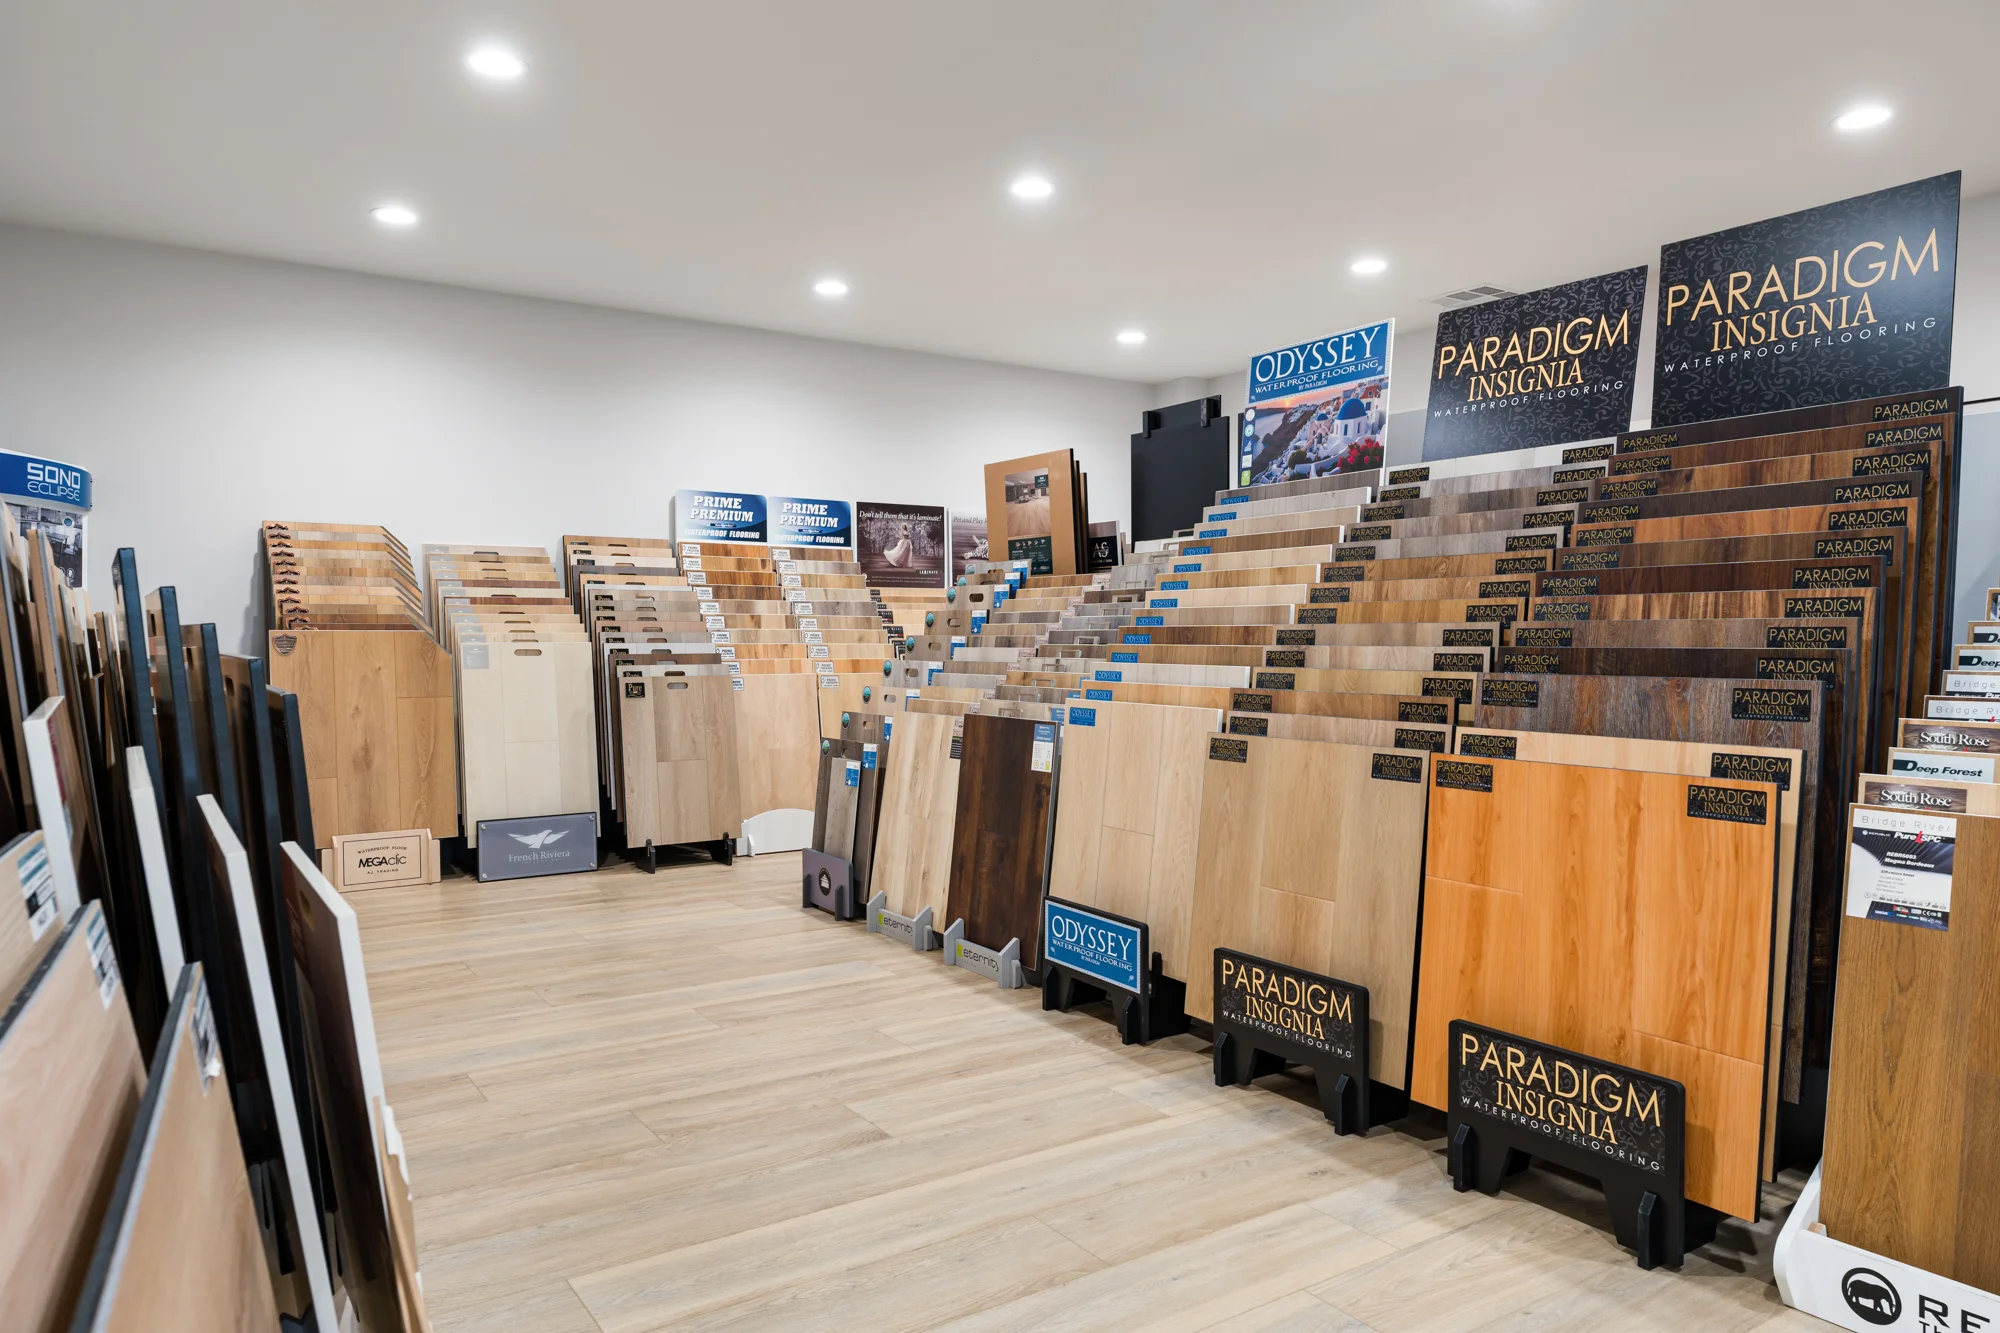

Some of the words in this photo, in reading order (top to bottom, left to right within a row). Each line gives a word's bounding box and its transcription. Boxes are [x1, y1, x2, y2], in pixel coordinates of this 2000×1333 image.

[1666, 227, 1939, 326] PARADIGM
[1711, 292, 1877, 352] INSIGNIA
[1438, 309, 1629, 380] PARADIGM
[1664, 342, 1798, 373] WATERPROOF
[1814, 317, 1936, 347] FLOORING
[1255, 326, 1381, 382] ODYSSEY
[1255, 374, 1319, 394] WATERPROOF
[1321, 360, 1378, 379] FLOORING
[1468, 358, 1584, 402] INSIGNIA
[1434, 396, 1529, 417] WATERPROOF
[1539, 381, 1624, 401] FLOORING
[1874, 398, 1948, 418] PARADIGM
[1623, 434, 1678, 448] PARADIGM
[1867, 426, 1942, 444] PARADIGM
[1563, 447, 1613, 460] PARADIGM
[1615, 458, 1670, 470] PARADIGM
[1854, 452, 1928, 470] PARADIGM
[27, 462, 81, 489] SONO
[1390, 468, 1429, 479] PARADIGM
[1555, 469, 1605, 482] PARADIGM
[27, 481, 80, 501] ECLIPSE
[1381, 488, 1420, 498] PARADIGM
[1601, 480, 1657, 494] PARADIGM
[1835, 484, 1910, 500] PARADIGM
[1538, 490, 1588, 502] PARADIGM
[693, 496, 743, 509] PRIME
[782, 502, 828, 515] PRIME
[690, 509, 753, 522] PREMIUM
[898, 512, 908, 520] that
[909, 512, 917, 520] it's
[917, 513, 942, 521] laminate!
[1210, 513, 1234, 522] ODYSSEY
[1364, 507, 1403, 516] PARADIGM
[1585, 505, 1639, 518] PARADIGM
[779, 515, 838, 528] PREMIUM
[1524, 512, 1574, 525] PARADIGM
[1830, 510, 1905, 526] PARADIGM
[685, 529, 727, 537] WATERPROOF
[729, 530, 760, 539] FLOORING
[1201, 530, 1226, 538] ODYSSEY
[1351, 527, 1390, 536] PARADIGM
[1577, 529, 1632, 541] PARADIGM
[816, 536, 844, 544] FLOORING
[1506, 535, 1556, 548] PARADIGM
[1186, 548, 1209, 556] ODYSSEY
[1336, 548, 1375, 557] PARADIGM
[1817, 539, 1892, 554] PARADIGM
[1496, 559, 1546, 570] PARADIGM
[1562, 553, 1618, 565] PARADIGM
[1176, 564, 1200, 573] ODYSSEY
[1324, 567, 1363, 576] PARADIGM
[1795, 567, 1870, 582] PARADIGM
[1163, 581, 1188, 590] ODYSSEY
[1480, 582, 1530, 593] PARADIGM
[1542, 577, 1597, 588] PARADIGM
[1808, 581, 1853, 589] INSIGNIA
[1311, 588, 1349, 597] PARADIGM
[1152, 599, 1176, 607] ODYSSEY
[1535, 604, 1589, 613] PARADIGM
[1786, 599, 1862, 612] PARADIGM
[1299, 609, 1336, 617] PARADIGM
[1467, 606, 1517, 616] PARADIGM
[1138, 617, 1163, 625] ODYSSEY
[1125, 635, 1150, 643] ODYSSEY
[1443, 631, 1493, 640] PARADIGM
[1517, 628, 1571, 639] PARADIGM
[1769, 628, 1845, 641] PARADIGM
[1783, 641, 1828, 649] INSIGNIA
[1113, 653, 1138, 662] ODYSSEY
[1266, 652, 1304, 660] PARADIGM
[1435, 655, 1483, 665] PARADIGM
[1504, 655, 1559, 665] PARADIGM
[1759, 659, 1835, 673] PARADIGM
[1097, 671, 1121, 680] ODYSSEY
[1257, 674, 1294, 682] PARADIGM
[628, 683, 642, 692] Pure
[1424, 680, 1472, 690] PARADIGM
[1483, 681, 1537, 692] PARADIGM
[1954, 680, 1996, 689] Bridge
[1088, 691, 1110, 699] ODYSSEY
[1234, 695, 1271, 704] PARADIGM
[1734, 690, 1809, 706] PARADIGM
[1072, 709, 1094, 718] ODYSSEY
[1400, 704, 1448, 715] PARADIGM
[1748, 704, 1794, 716] INSIGNIA
[1936, 706, 1978, 715] Bridge
[1230, 717, 1267, 726] PARADIGM
[1396, 730, 1444, 743] PARADIGM
[1461, 736, 1515, 748] PARADIGM
[1920, 730, 1955, 745] South
[1958, 733, 1990, 747] Rose
[1211, 739, 1247, 749] PARADIGM
[1373, 754, 1421, 768] PARADIGM
[1713, 754, 1789, 773] PARADIGM
[1437, 762, 1492, 776] PARADIGM
[1892, 759, 1939, 775] Deep
[1941, 766, 1983, 777] Forest
[1728, 769, 1773, 783] INSIGNIA
[1689, 787, 1766, 807] PARADIGM
[1881, 789, 1917, 804] South
[1920, 792, 1952, 807] Rose
[1704, 802, 1750, 816] INSIGNIA
[1862, 815, 1905, 828] Bridge
[1914, 820, 1951, 832] River
[357, 846, 389, 854] WATERPROOF
[508, 851, 538, 862] French
[540, 850, 570, 860] Riviera
[1906, 860, 1935, 868] Bordeaux
[1052, 915, 1132, 961] ODYSSEY
[963, 948, 999, 972] eternity
[1052, 939, 1094, 957] WATERPROOF
[1095, 954, 1132, 971] FLOORING
[1222, 959, 1352, 1024] PARADIGM
[1245, 995, 1325, 1040] INSIGNIA
[1223, 1010, 1288, 1037] WATERPROOF
[1295, 1034, 1352, 1058] FLOORING
[1461, 1033, 1661, 1127] PARADIGM
[1496, 1080, 1618, 1145] INSIGNIA
[1462, 1096, 1561, 1136] WATERPROOF
[1572, 1133, 1660, 1171] FLOORING
